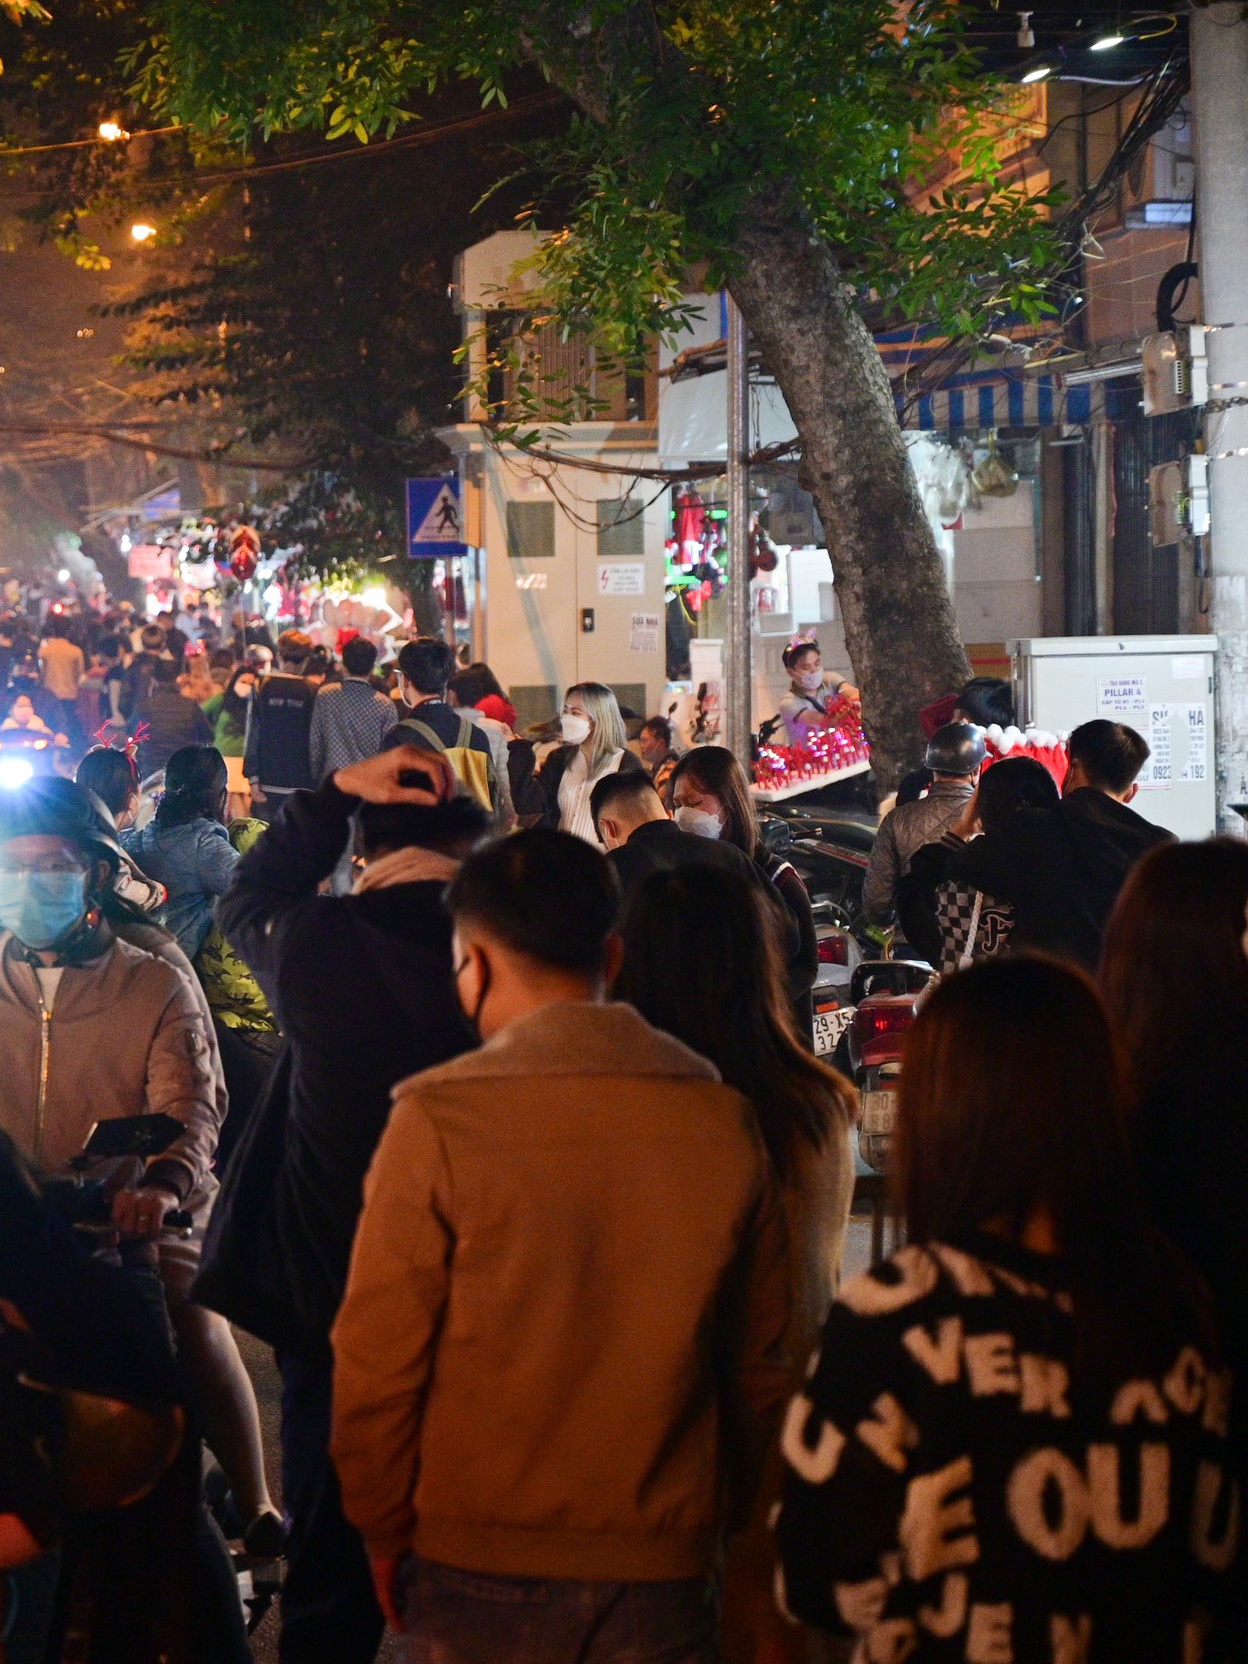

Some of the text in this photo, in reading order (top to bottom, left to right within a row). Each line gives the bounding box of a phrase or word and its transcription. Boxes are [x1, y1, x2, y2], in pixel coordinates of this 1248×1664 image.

[1104, 688, 1142, 697] PILLAR 4
[1190, 764, 1204, 779] 192
